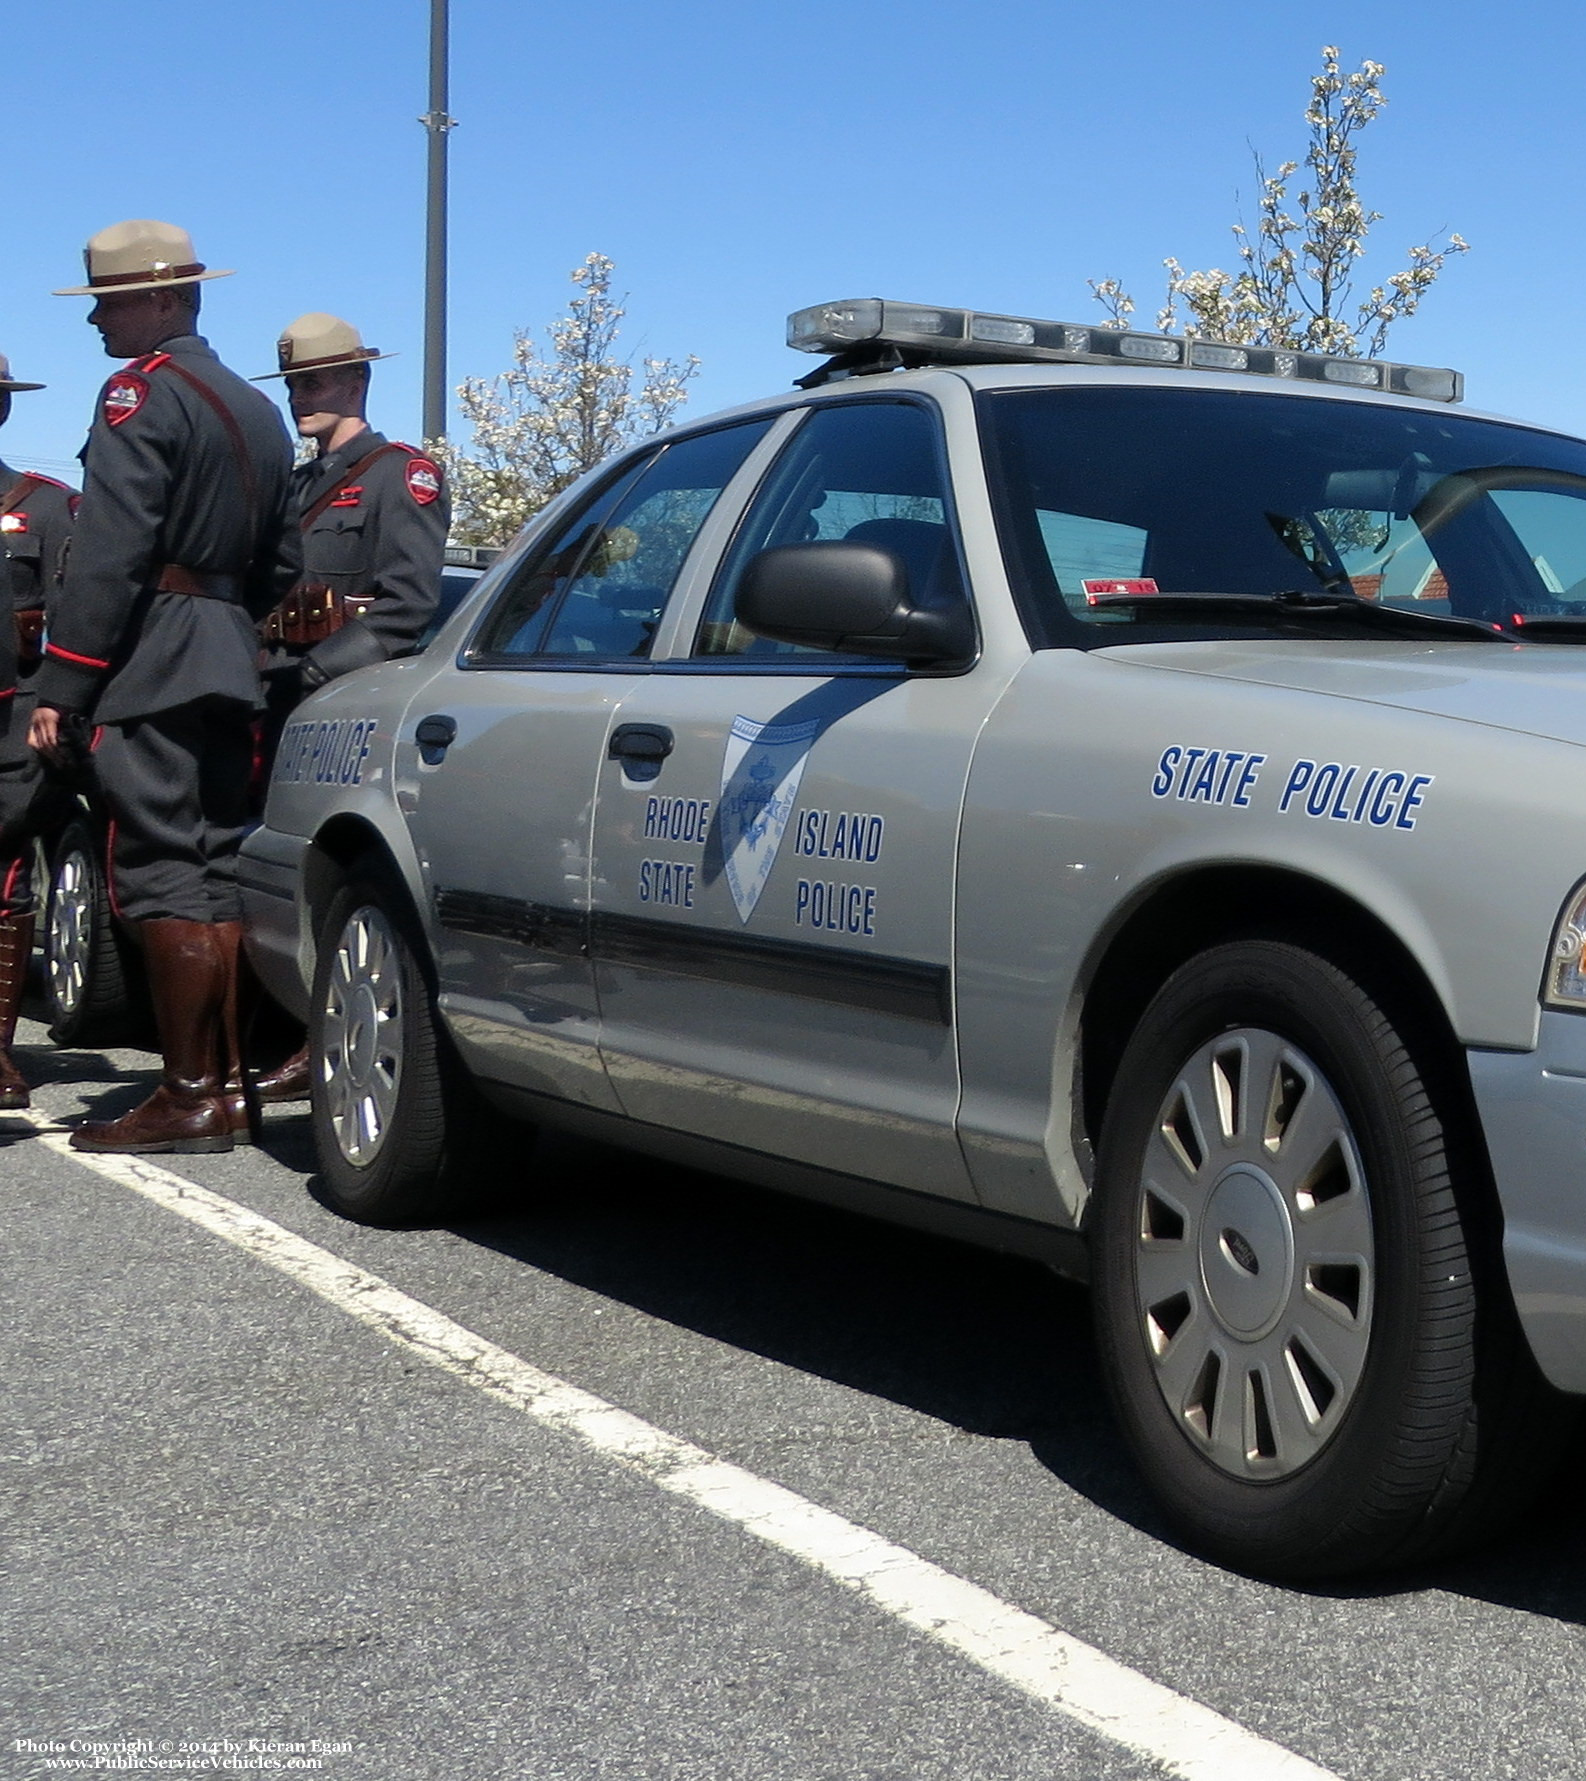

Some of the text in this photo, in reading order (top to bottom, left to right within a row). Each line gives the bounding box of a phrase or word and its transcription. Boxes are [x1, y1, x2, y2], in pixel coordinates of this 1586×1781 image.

[311, 719, 378, 787] POLICE
[1152, 744, 1435, 832] STATE POLICE
[644, 796, 711, 844] RHODE
[795, 809, 885, 865] ISLAND
[639, 858, 696, 909] STATE
[796, 878, 878, 938] POLICE
